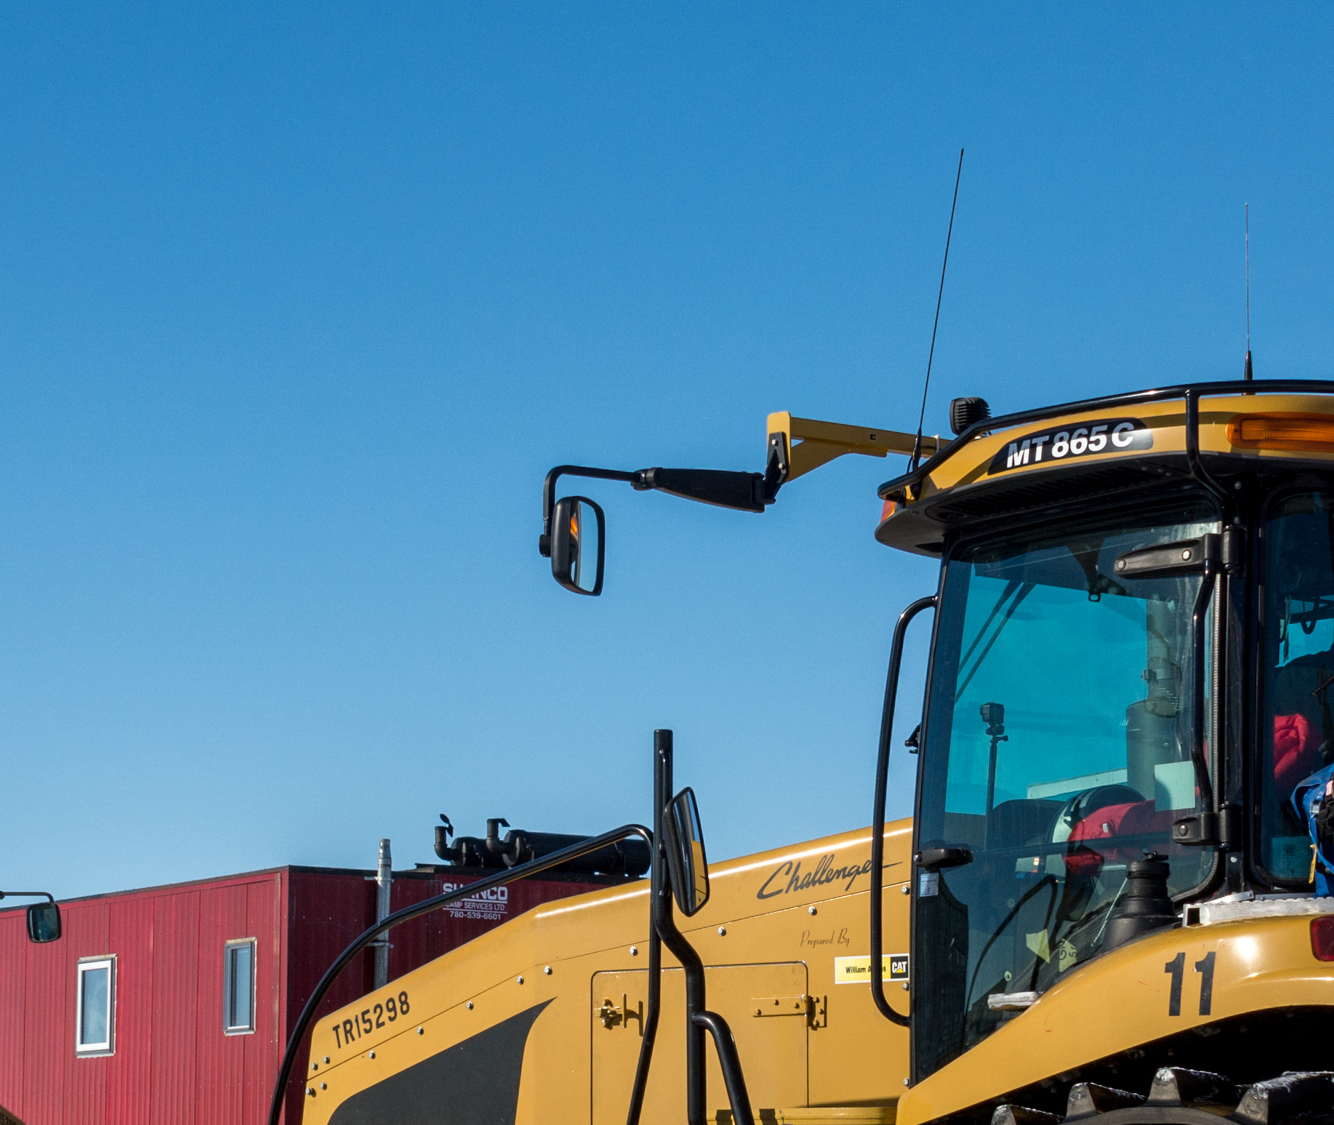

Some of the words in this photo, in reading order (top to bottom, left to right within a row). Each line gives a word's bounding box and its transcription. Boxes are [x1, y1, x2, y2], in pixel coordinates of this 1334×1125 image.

[464, 902, 493, 911] SERVICES
[494, 903, 505, 911] LTD
[837, 927, 850, 949] By
[845, 965, 866, 974] William
[891, 961, 907, 974] CAT
[1164, 951, 1216, 1017] 11
[332, 990, 411, 1049] TR15298
